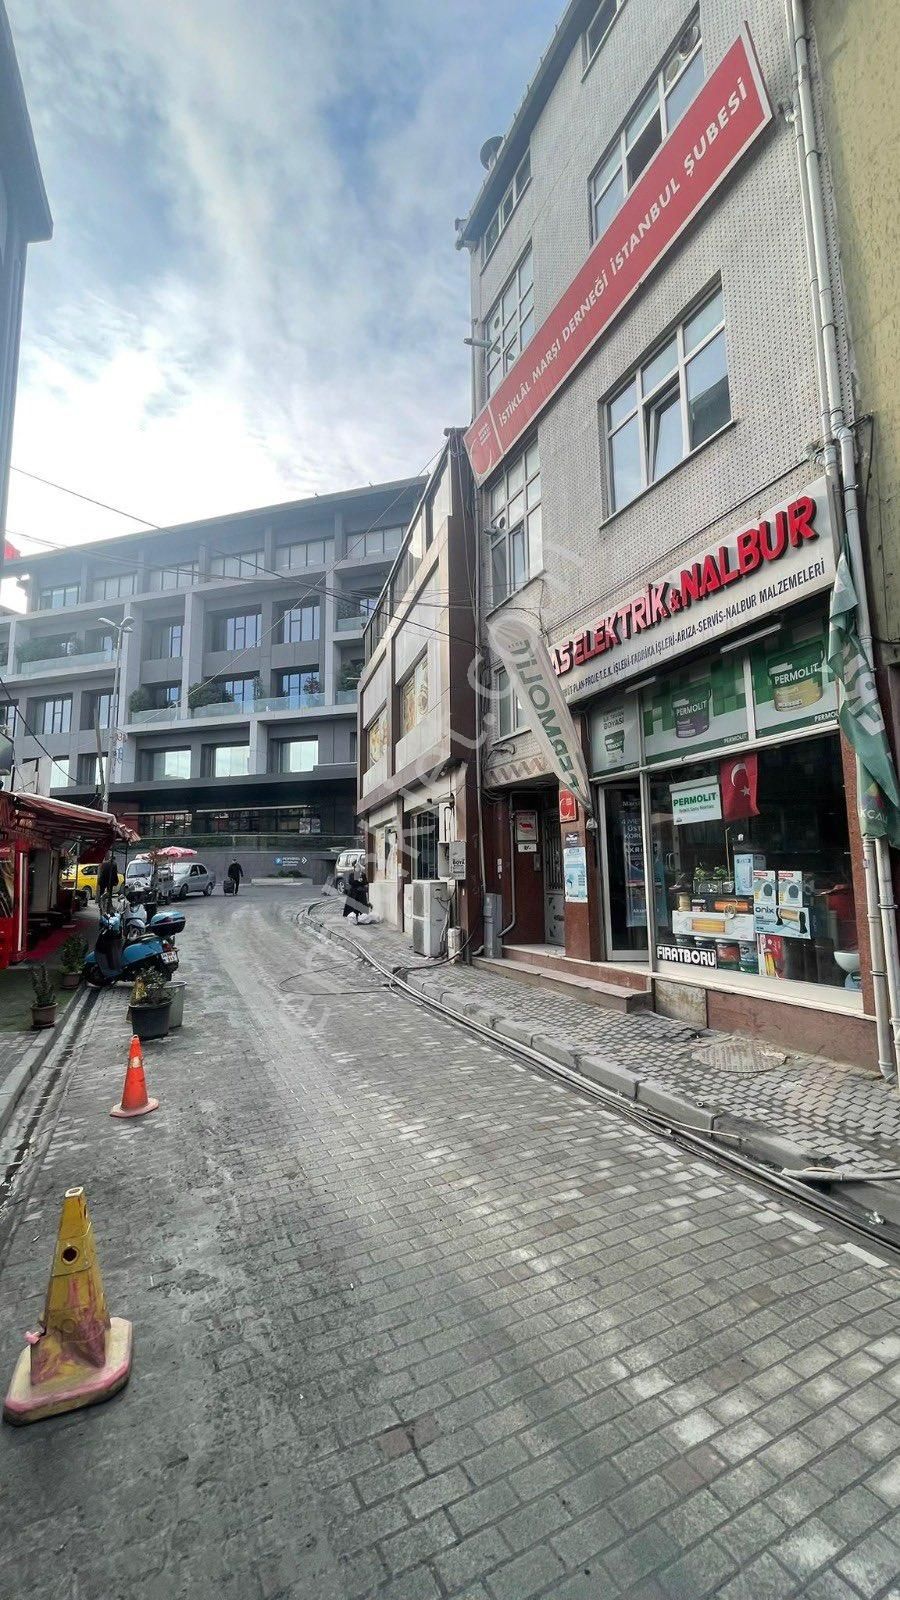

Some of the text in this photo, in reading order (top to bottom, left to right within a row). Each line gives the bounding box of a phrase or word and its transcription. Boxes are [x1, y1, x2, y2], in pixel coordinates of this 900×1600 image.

[498, 77, 748, 427] İSTİKLÂL MARŞI DERNEĞİ İSTANBUL ŞUBESİ
[680, 496, 818, 608] NALBUR
[759, 557, 825, 603] MALZEMELERİ
